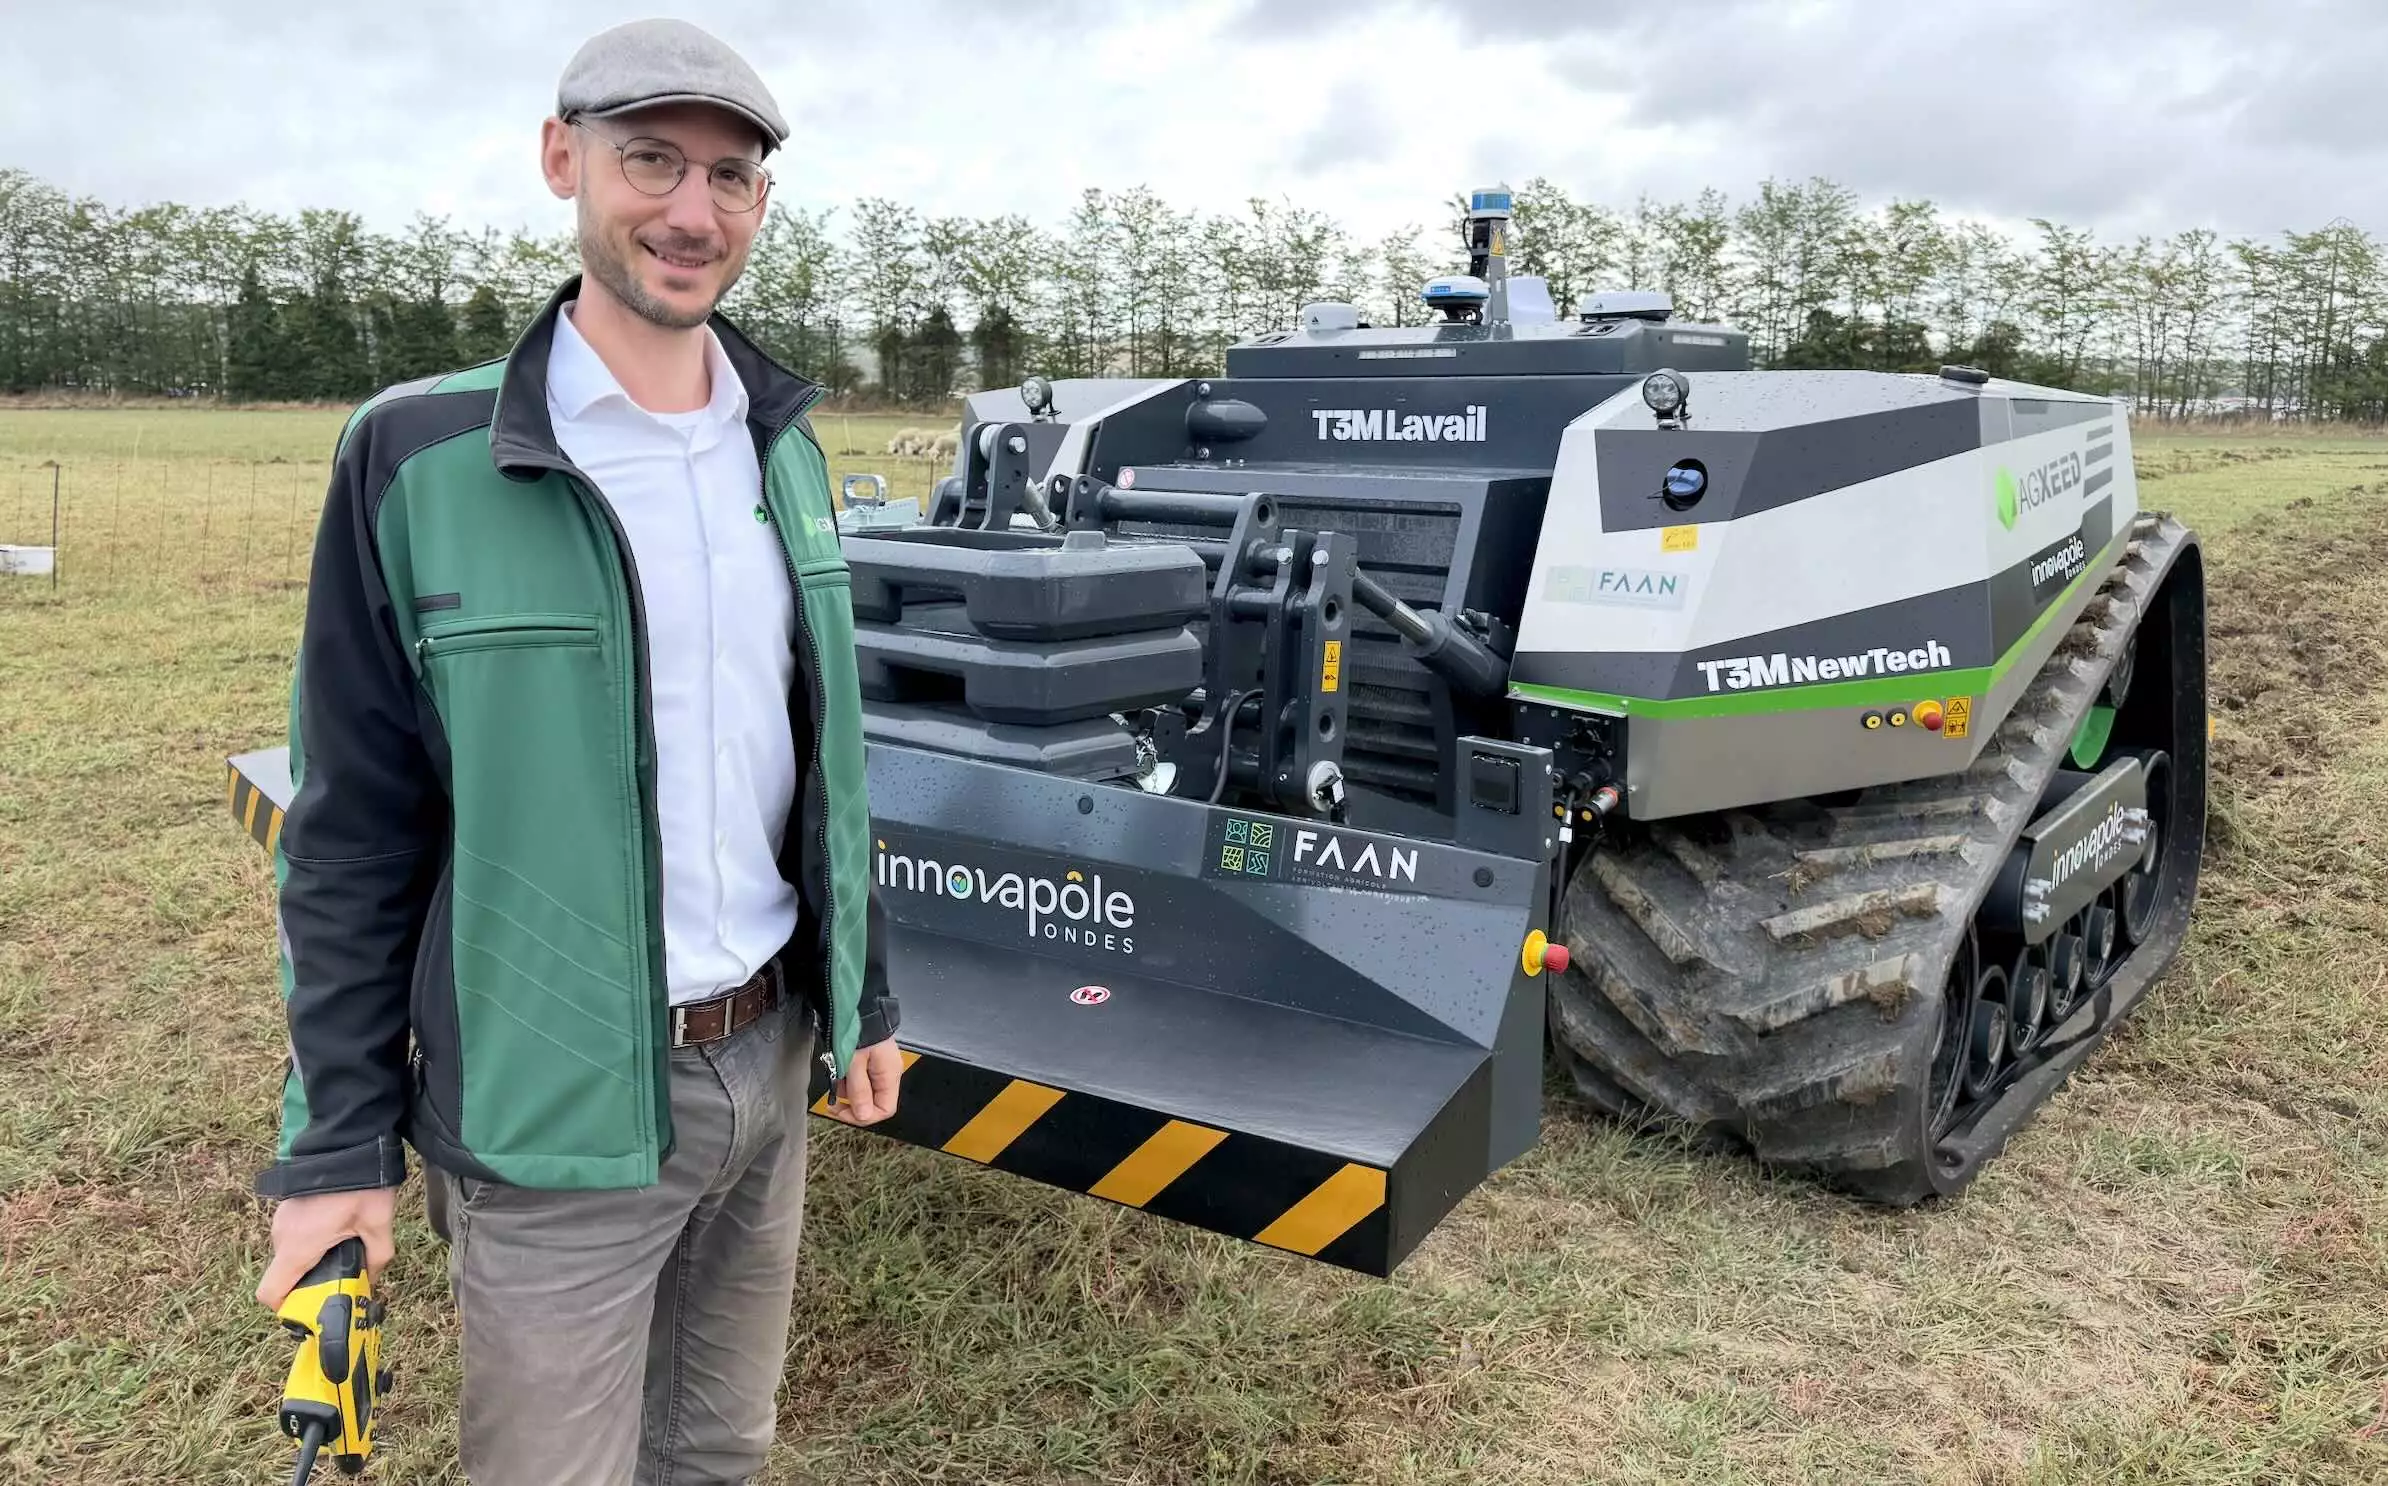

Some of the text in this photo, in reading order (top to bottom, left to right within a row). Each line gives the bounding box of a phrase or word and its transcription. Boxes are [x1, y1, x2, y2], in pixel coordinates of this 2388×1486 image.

[1311, 404, 1488, 442] T3M Lavail
[2018, 450, 2082, 515] AGXEED
[1599, 571, 1678, 595] FAAN
[1697, 639, 1952, 692] T3M NewTech
[1293, 829, 1419, 884] FAAN
[2052, 800, 2124, 890] innovapôle
[877, 839, 1136, 937] innovapôle
[1044, 922, 1135, 955] ONDES
